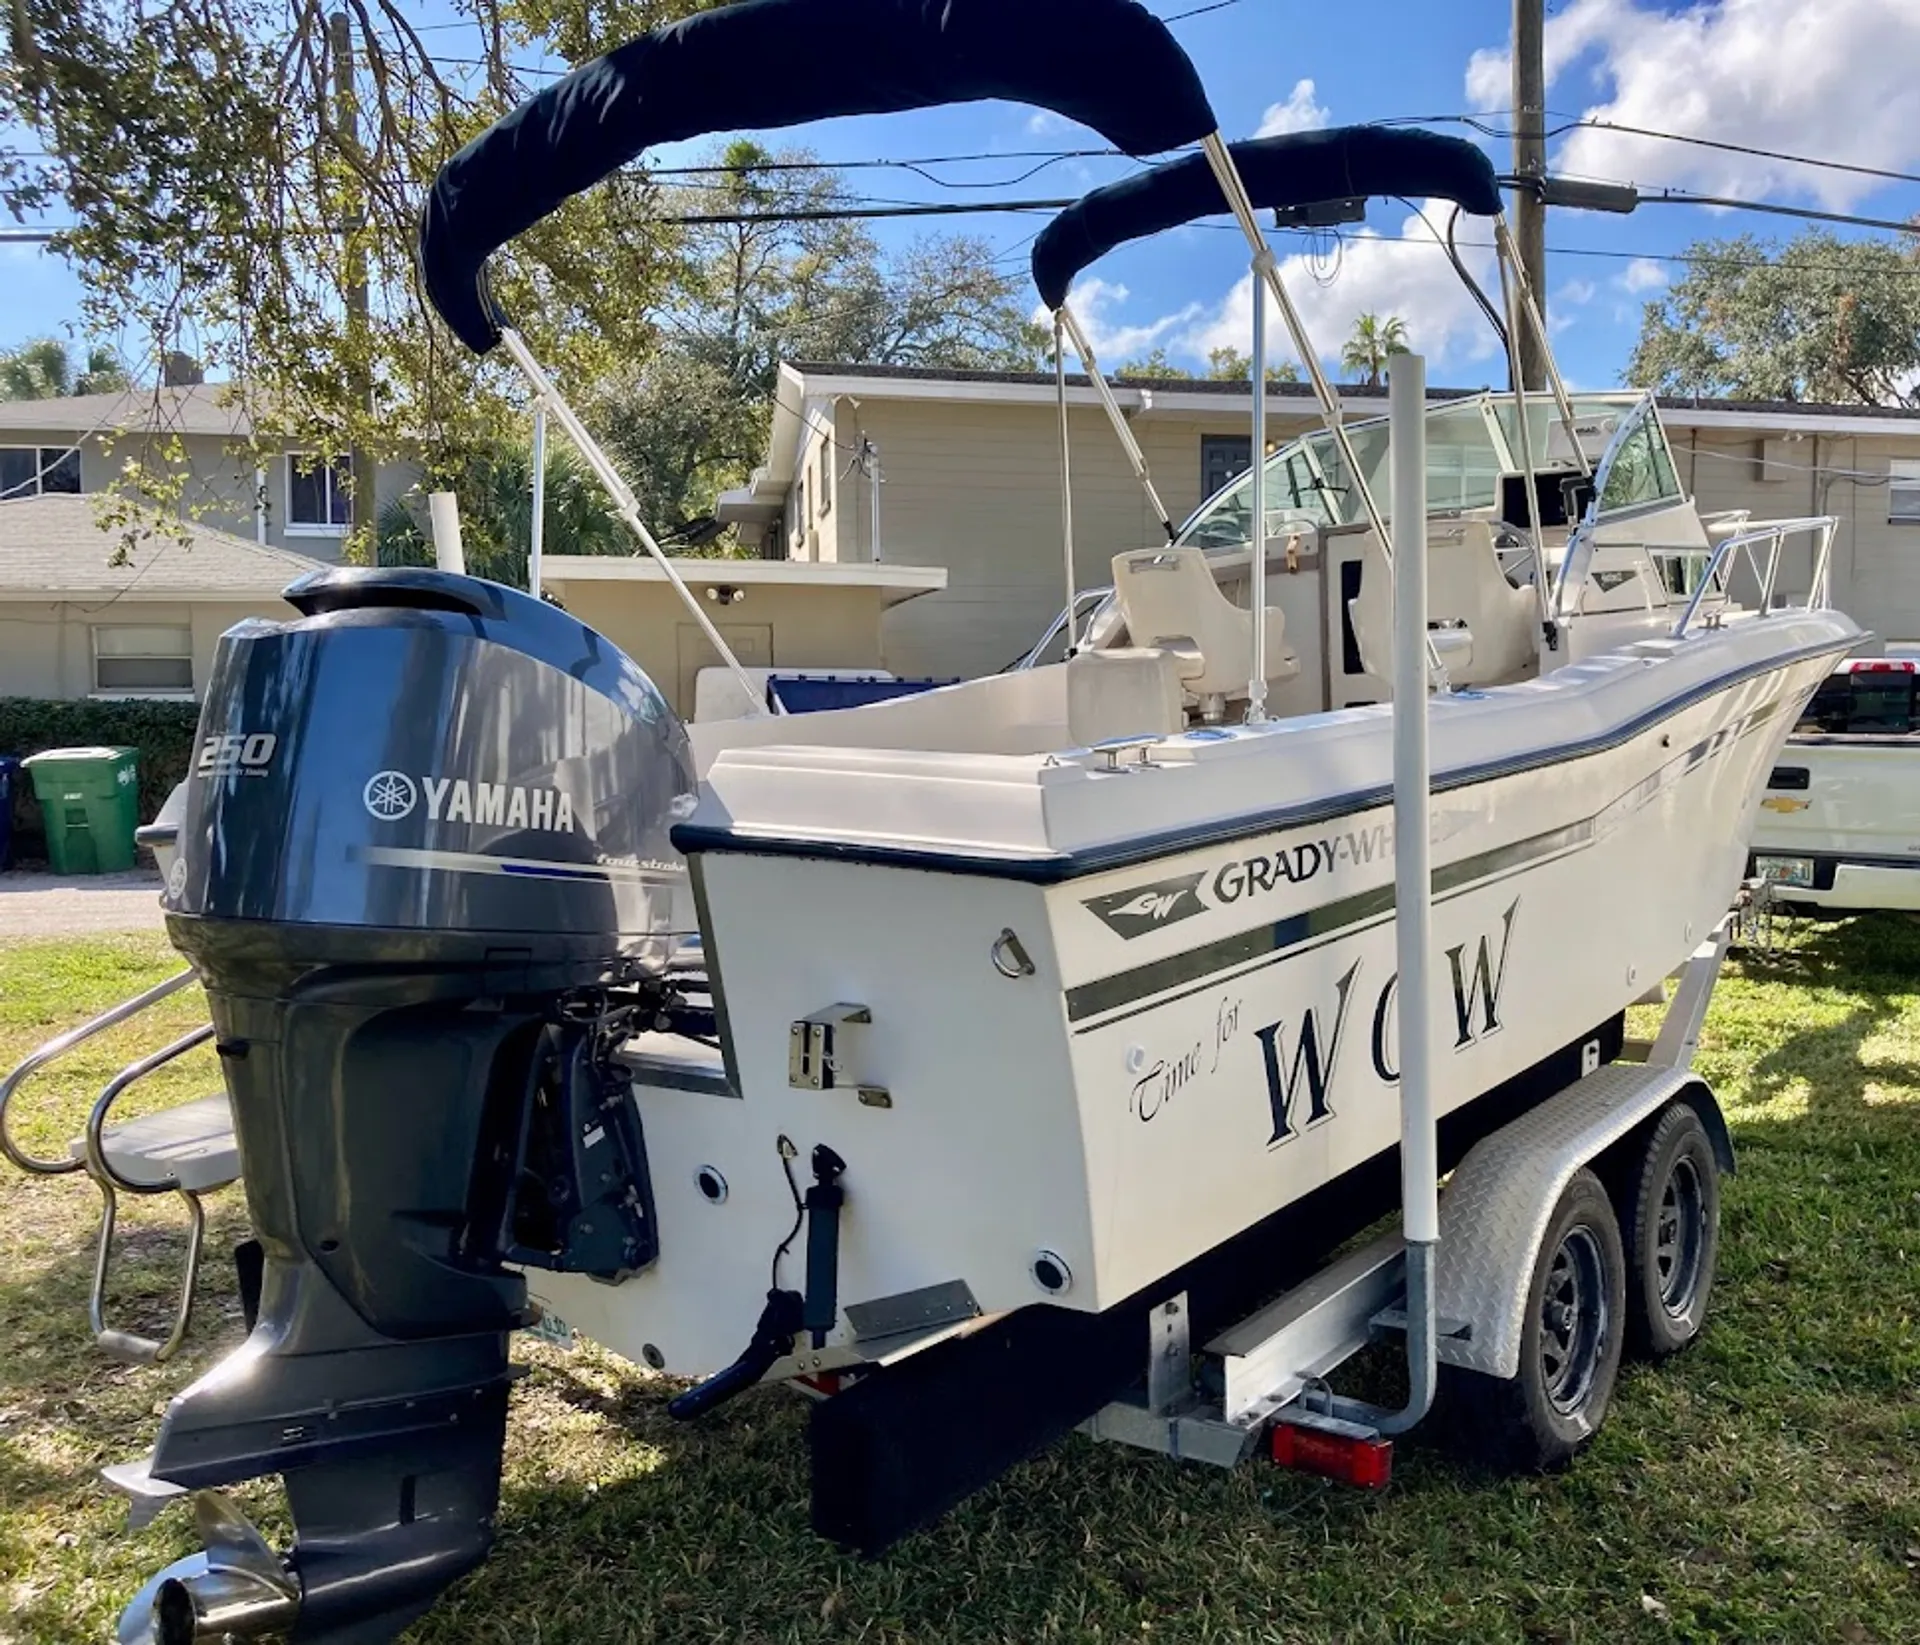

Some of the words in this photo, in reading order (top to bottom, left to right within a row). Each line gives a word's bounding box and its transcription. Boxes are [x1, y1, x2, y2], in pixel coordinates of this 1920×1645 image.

[199, 733, 277, 766] 250
[422, 776, 575, 833] YAMAHA
[1212, 807, 1441, 904] GRADY-WH
[1129, 1040, 1201, 1123] Time
[1210, 996, 1243, 1074] for
